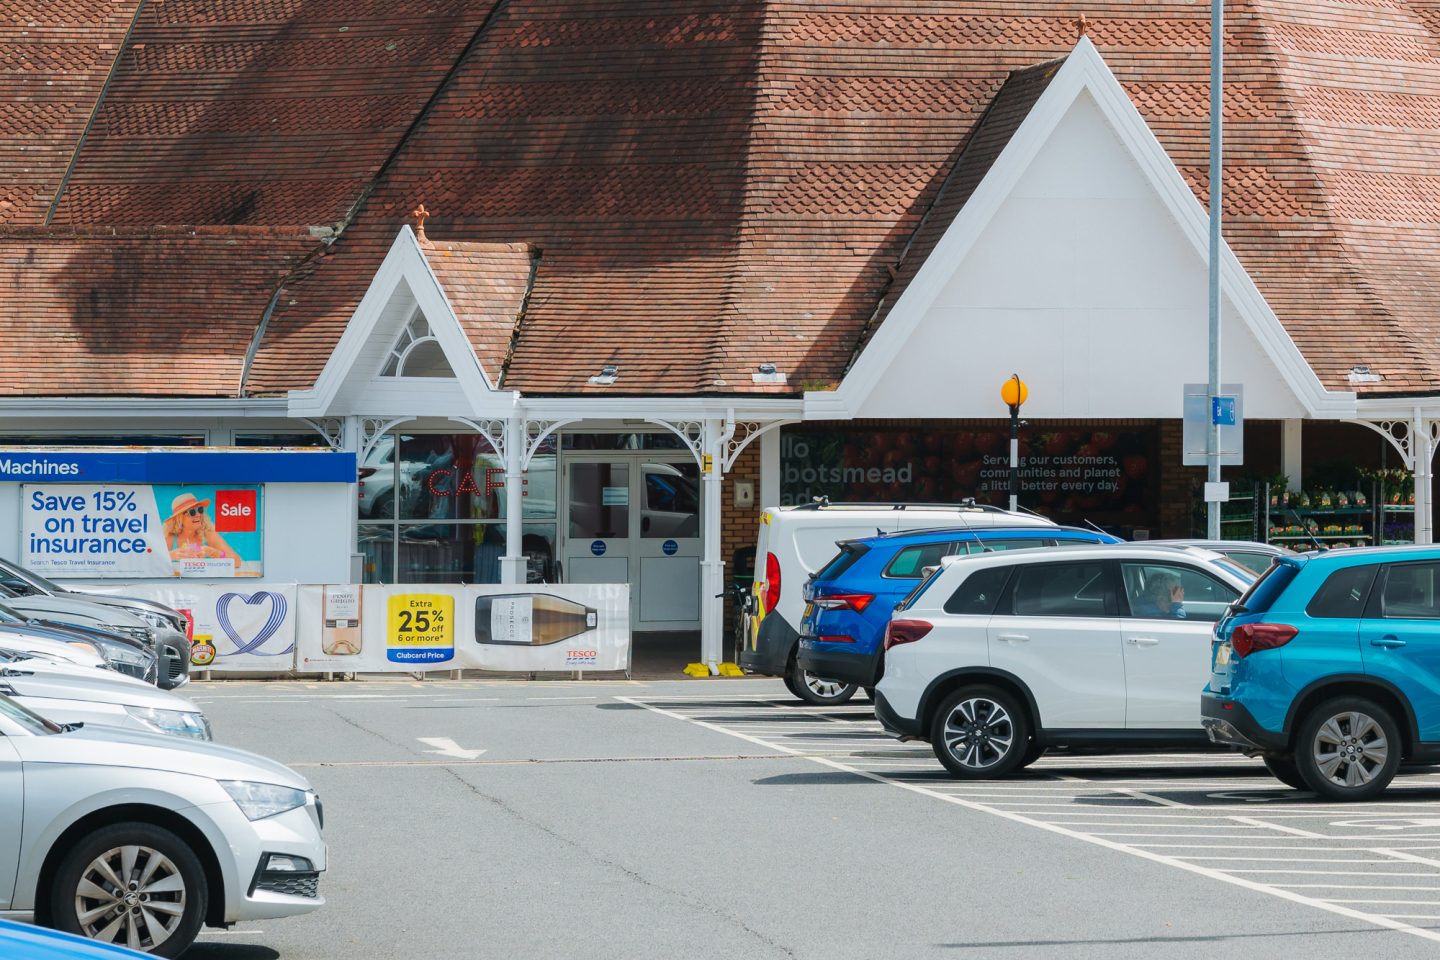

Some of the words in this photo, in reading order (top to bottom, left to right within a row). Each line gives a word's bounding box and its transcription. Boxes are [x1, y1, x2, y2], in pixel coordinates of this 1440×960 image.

[782, 437, 809, 458] llo
[983, 454, 1026, 467] Servg
[1053, 456, 1118, 466] customers,
[780, 462, 912, 483] botsmead
[1059, 468, 1080, 478] and
[1084, 467, 1121, 480] planet
[428, 468, 528, 497] CAF
[991, 480, 1010, 490] littl
[1022, 480, 1058, 490] better
[1061, 482, 1094, 493] every
[1097, 480, 1119, 493] day.
[31, 490, 86, 512] Save
[93, 490, 136, 512] 15%
[782, 488, 811, 506] ad
[220, 503, 252, 516] Sale
[44, 517, 74, 533] on
[83, 514, 148, 533] travel
[30, 533, 152, 554] insurance.
